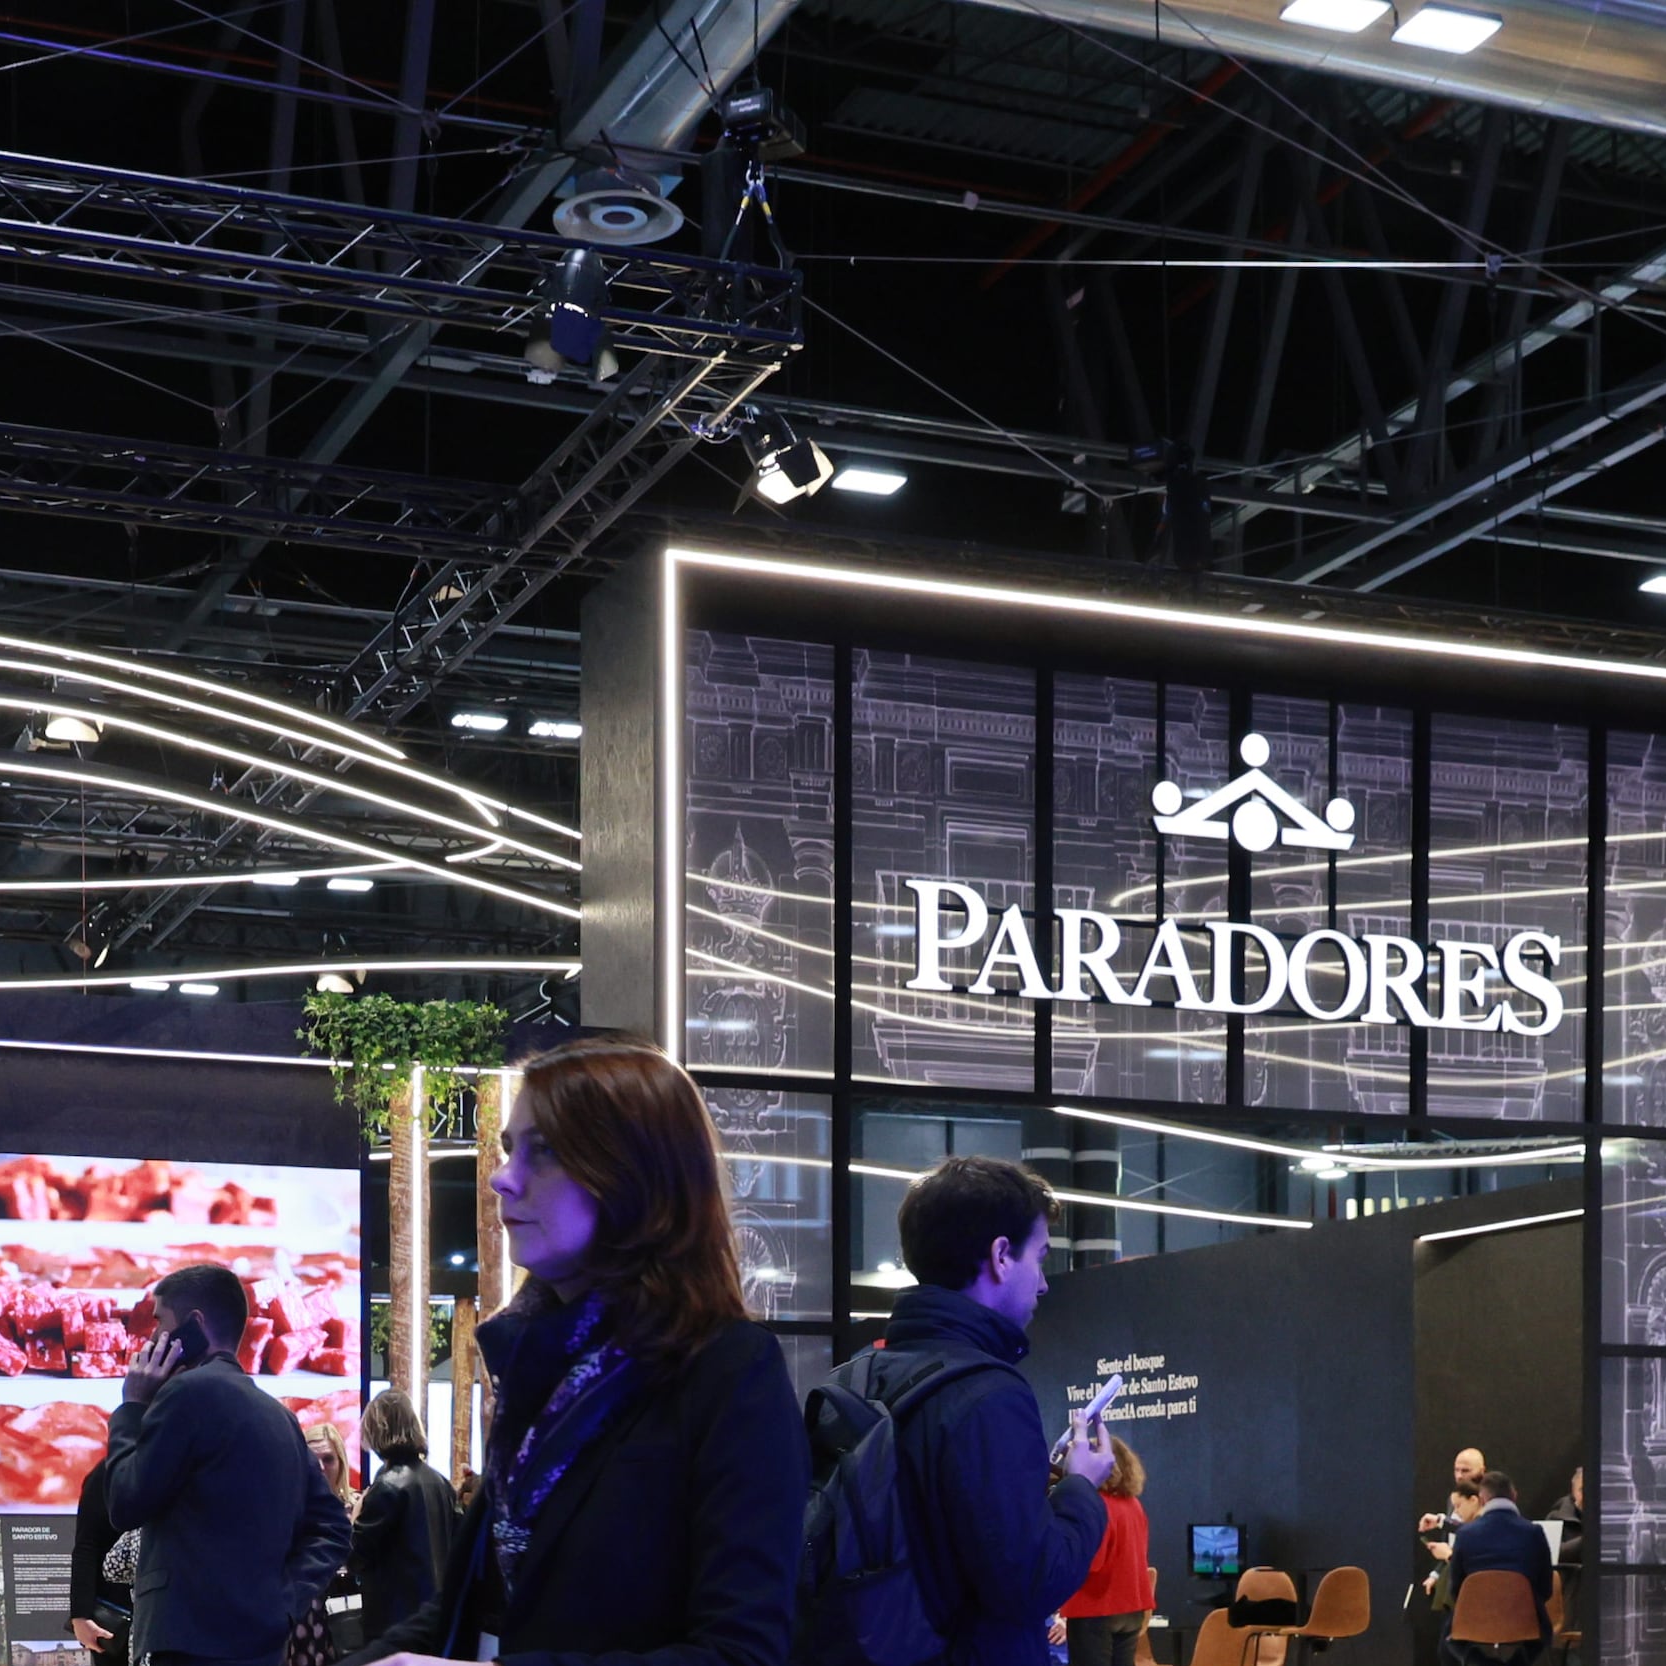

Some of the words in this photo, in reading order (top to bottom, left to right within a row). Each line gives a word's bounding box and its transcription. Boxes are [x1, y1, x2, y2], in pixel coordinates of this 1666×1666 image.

[905, 879, 1564, 1037] PARADORES
[1097, 1358, 1123, 1376] Siente
[1123, 1354, 1132, 1372] el
[1133, 1353, 1165, 1373] bosque
[1067, 1384, 1086, 1402] Vive
[1086, 1383, 1094, 1400] el
[1129, 1377, 1140, 1396] de
[1141, 1376, 1167, 1394] Santo
[1168, 1373, 1199, 1392] Estevo
[1136, 1398, 1166, 1419] creada
[1167, 1399, 1189, 1420] para
[1189, 1395, 1197, 1413] ti
[11, 1526, 41, 1534] PARADOR
[41, 1526, 51, 1534] DE
[12, 1533, 34, 1541] SANTO
[34, 1533, 58, 1541] ESTEVO
